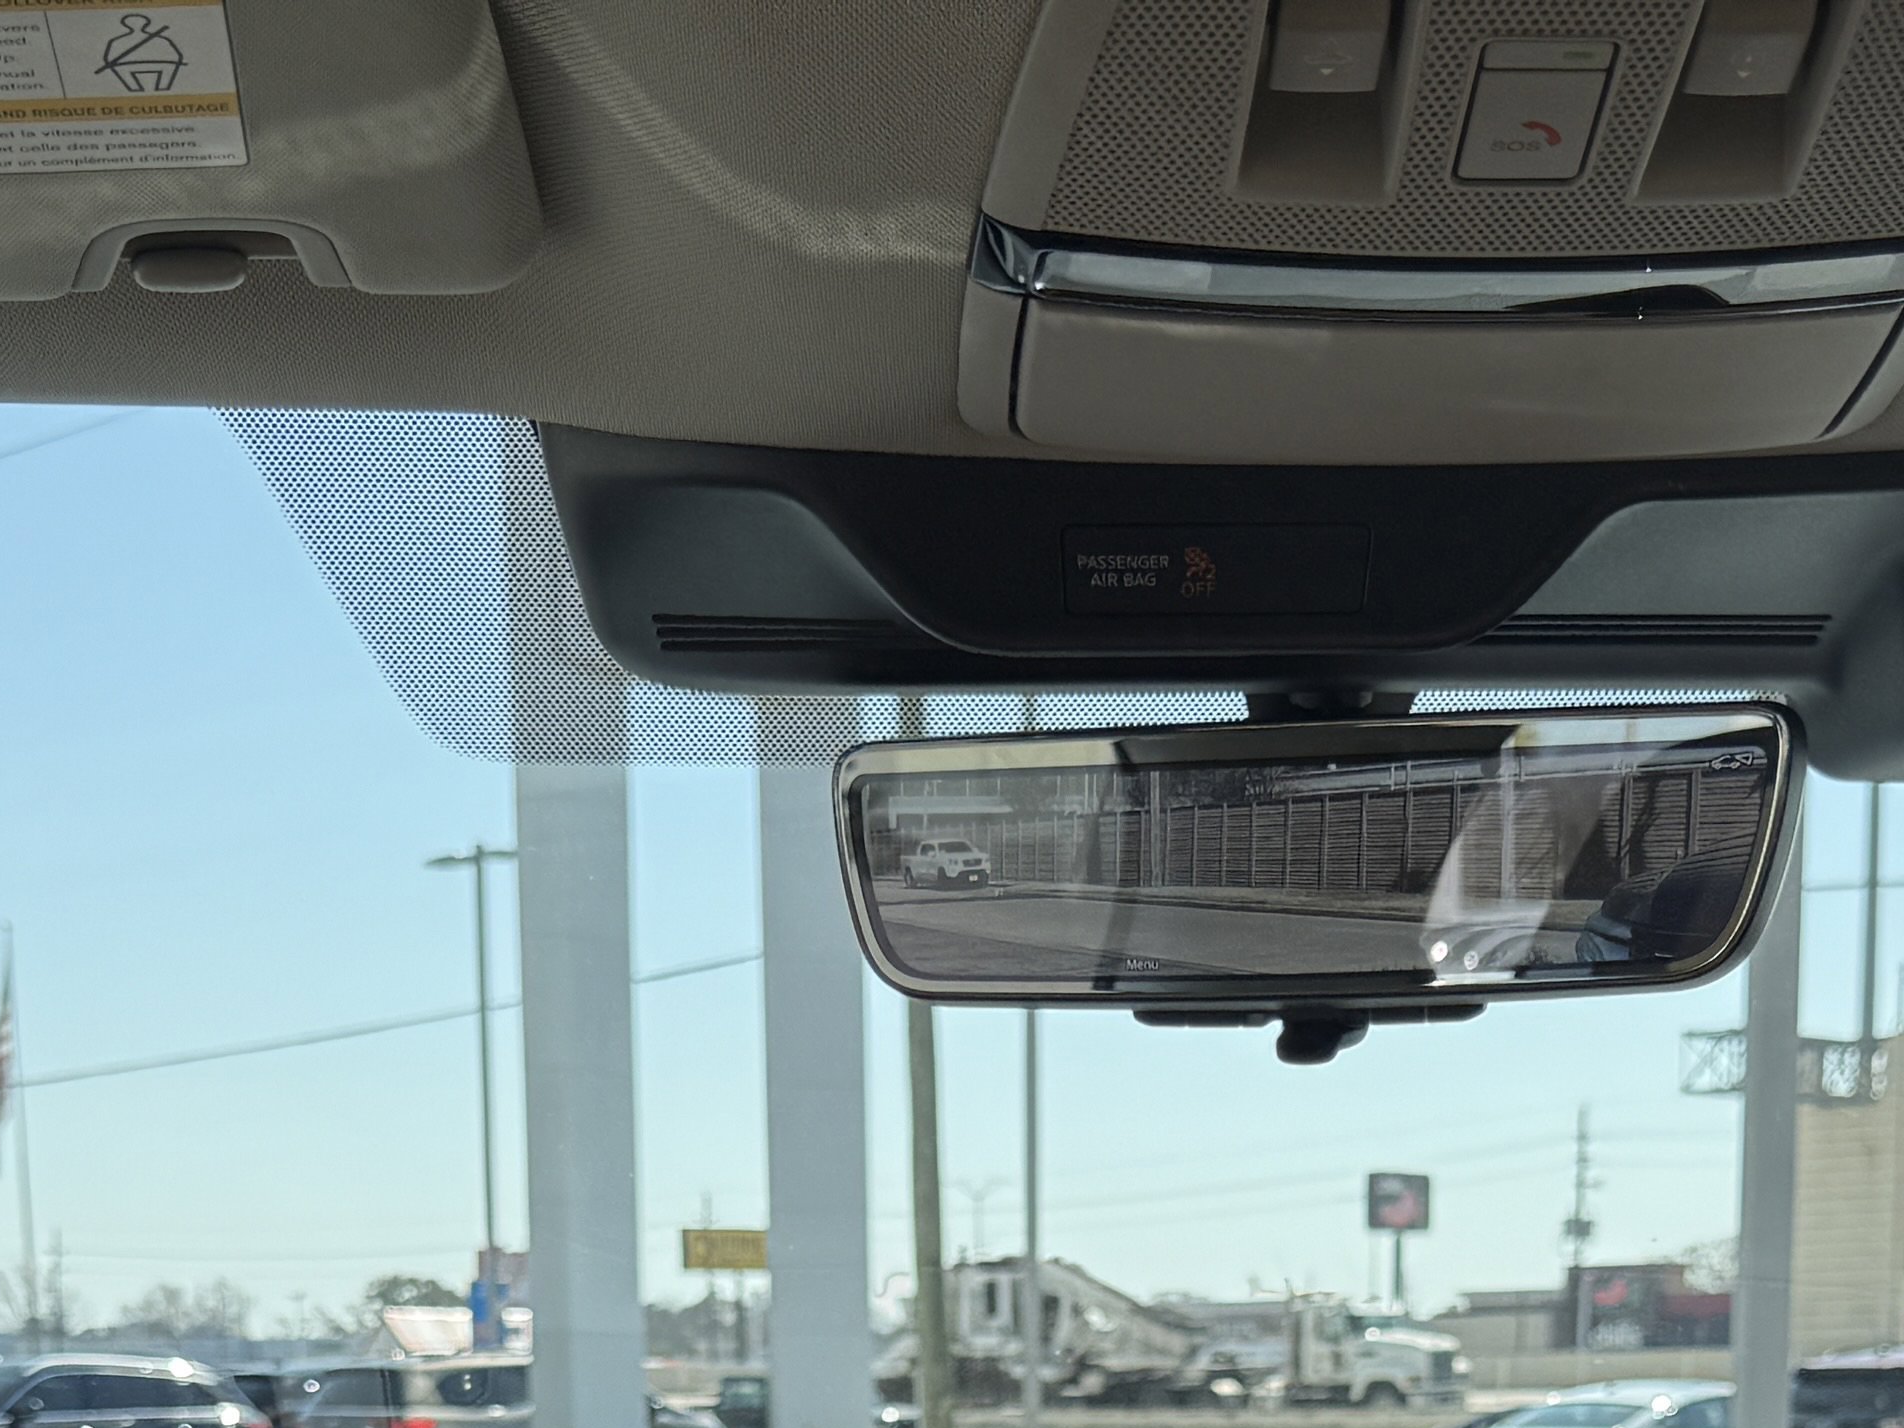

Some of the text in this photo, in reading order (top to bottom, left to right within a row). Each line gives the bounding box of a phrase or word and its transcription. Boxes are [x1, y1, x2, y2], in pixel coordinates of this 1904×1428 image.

[32, 107, 97, 119] RISQUE
[101, 106, 125, 117] DE
[129, 103, 230, 115] CULBUTAGE
[1491, 140, 1541, 151] SOS
[1077, 554, 1170, 570] PASSENGER
[1091, 572, 1157, 587] AIR BAG
[1181, 582, 1217, 598] OFF
[1126, 959, 1159, 970] Menu
